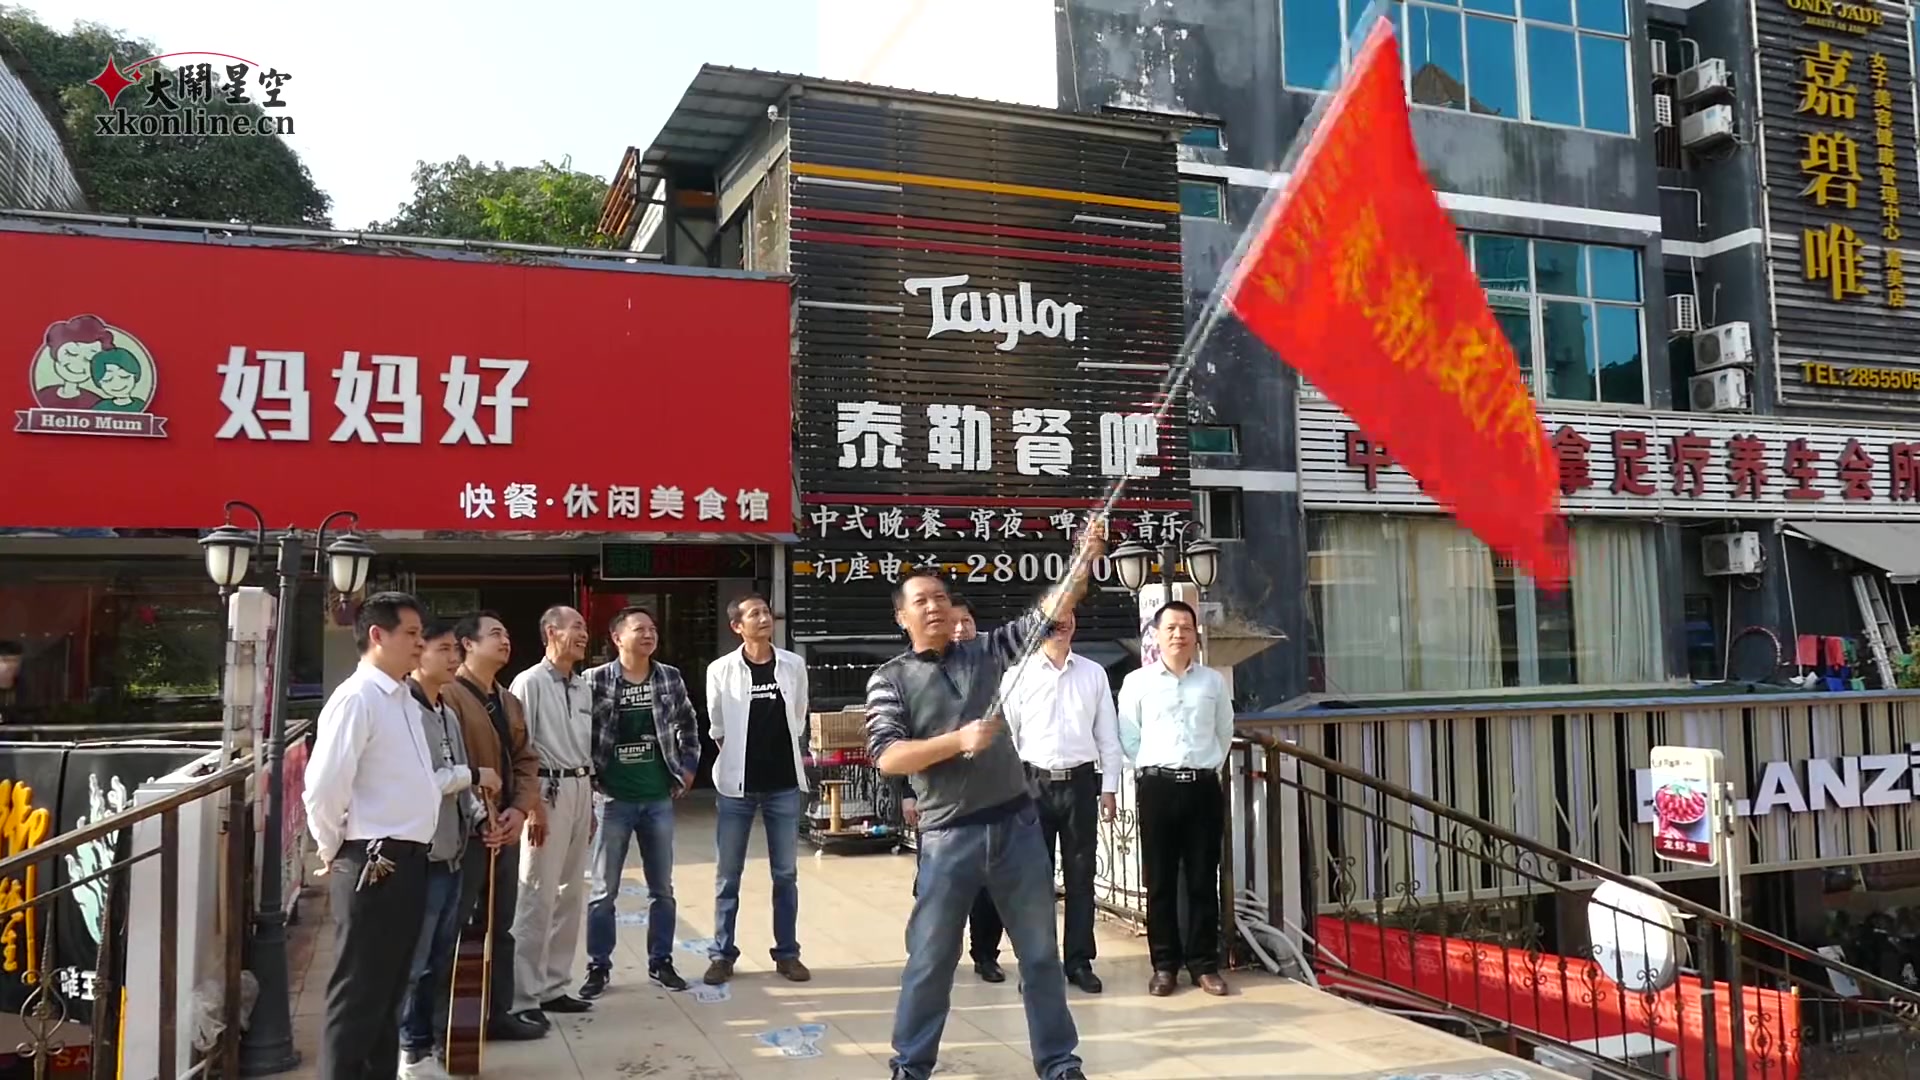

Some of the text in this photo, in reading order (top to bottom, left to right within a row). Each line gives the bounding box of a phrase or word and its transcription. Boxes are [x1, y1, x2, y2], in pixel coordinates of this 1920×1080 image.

[1786, 0, 1884, 25] ONLY JADE
[1793, 40, 1871, 301] 嘉碧唯
[904, 274, 1083, 351] Taylor
[40, 413, 143, 431] Hello Mum
[214, 345, 530, 446] 妈妈好
[837, 401, 1160, 477] 泰勒餐吧
[1345, 424, 1920, 502] 中拿足疗养生会所
[460, 482, 770, 521] 快餐·休闲美食馆
[810, 505, 1184, 541] 中式晚餐、宵夜、啤、音乐
